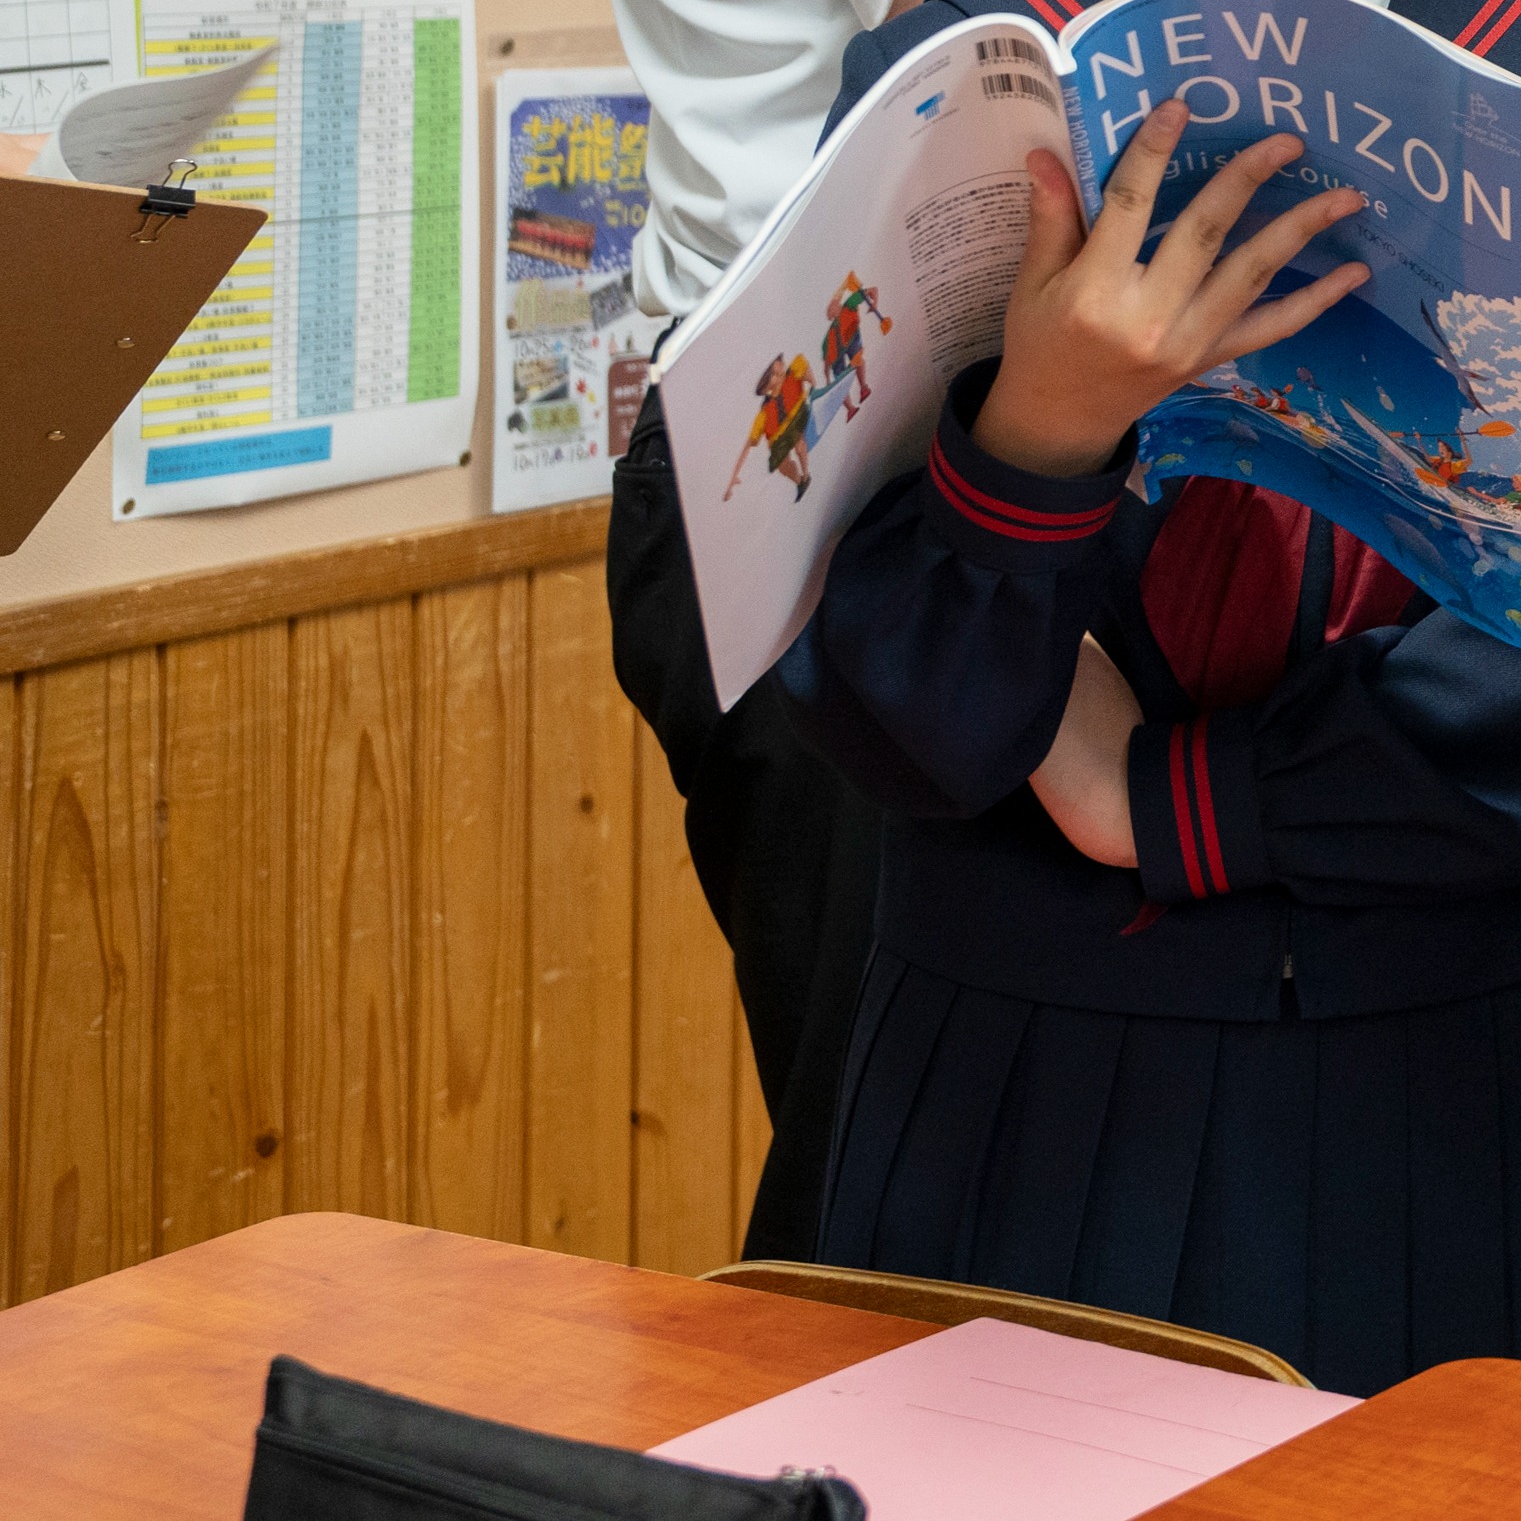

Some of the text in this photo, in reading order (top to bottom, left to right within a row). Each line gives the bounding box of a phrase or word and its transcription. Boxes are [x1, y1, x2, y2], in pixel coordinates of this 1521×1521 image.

[1090, 10, 1309, 99] NEW
[1063, 86, 1084, 116] NEW
[1069, 119, 1096, 181] HORIZON
[1101, 75, 1512, 242] HORIZON
